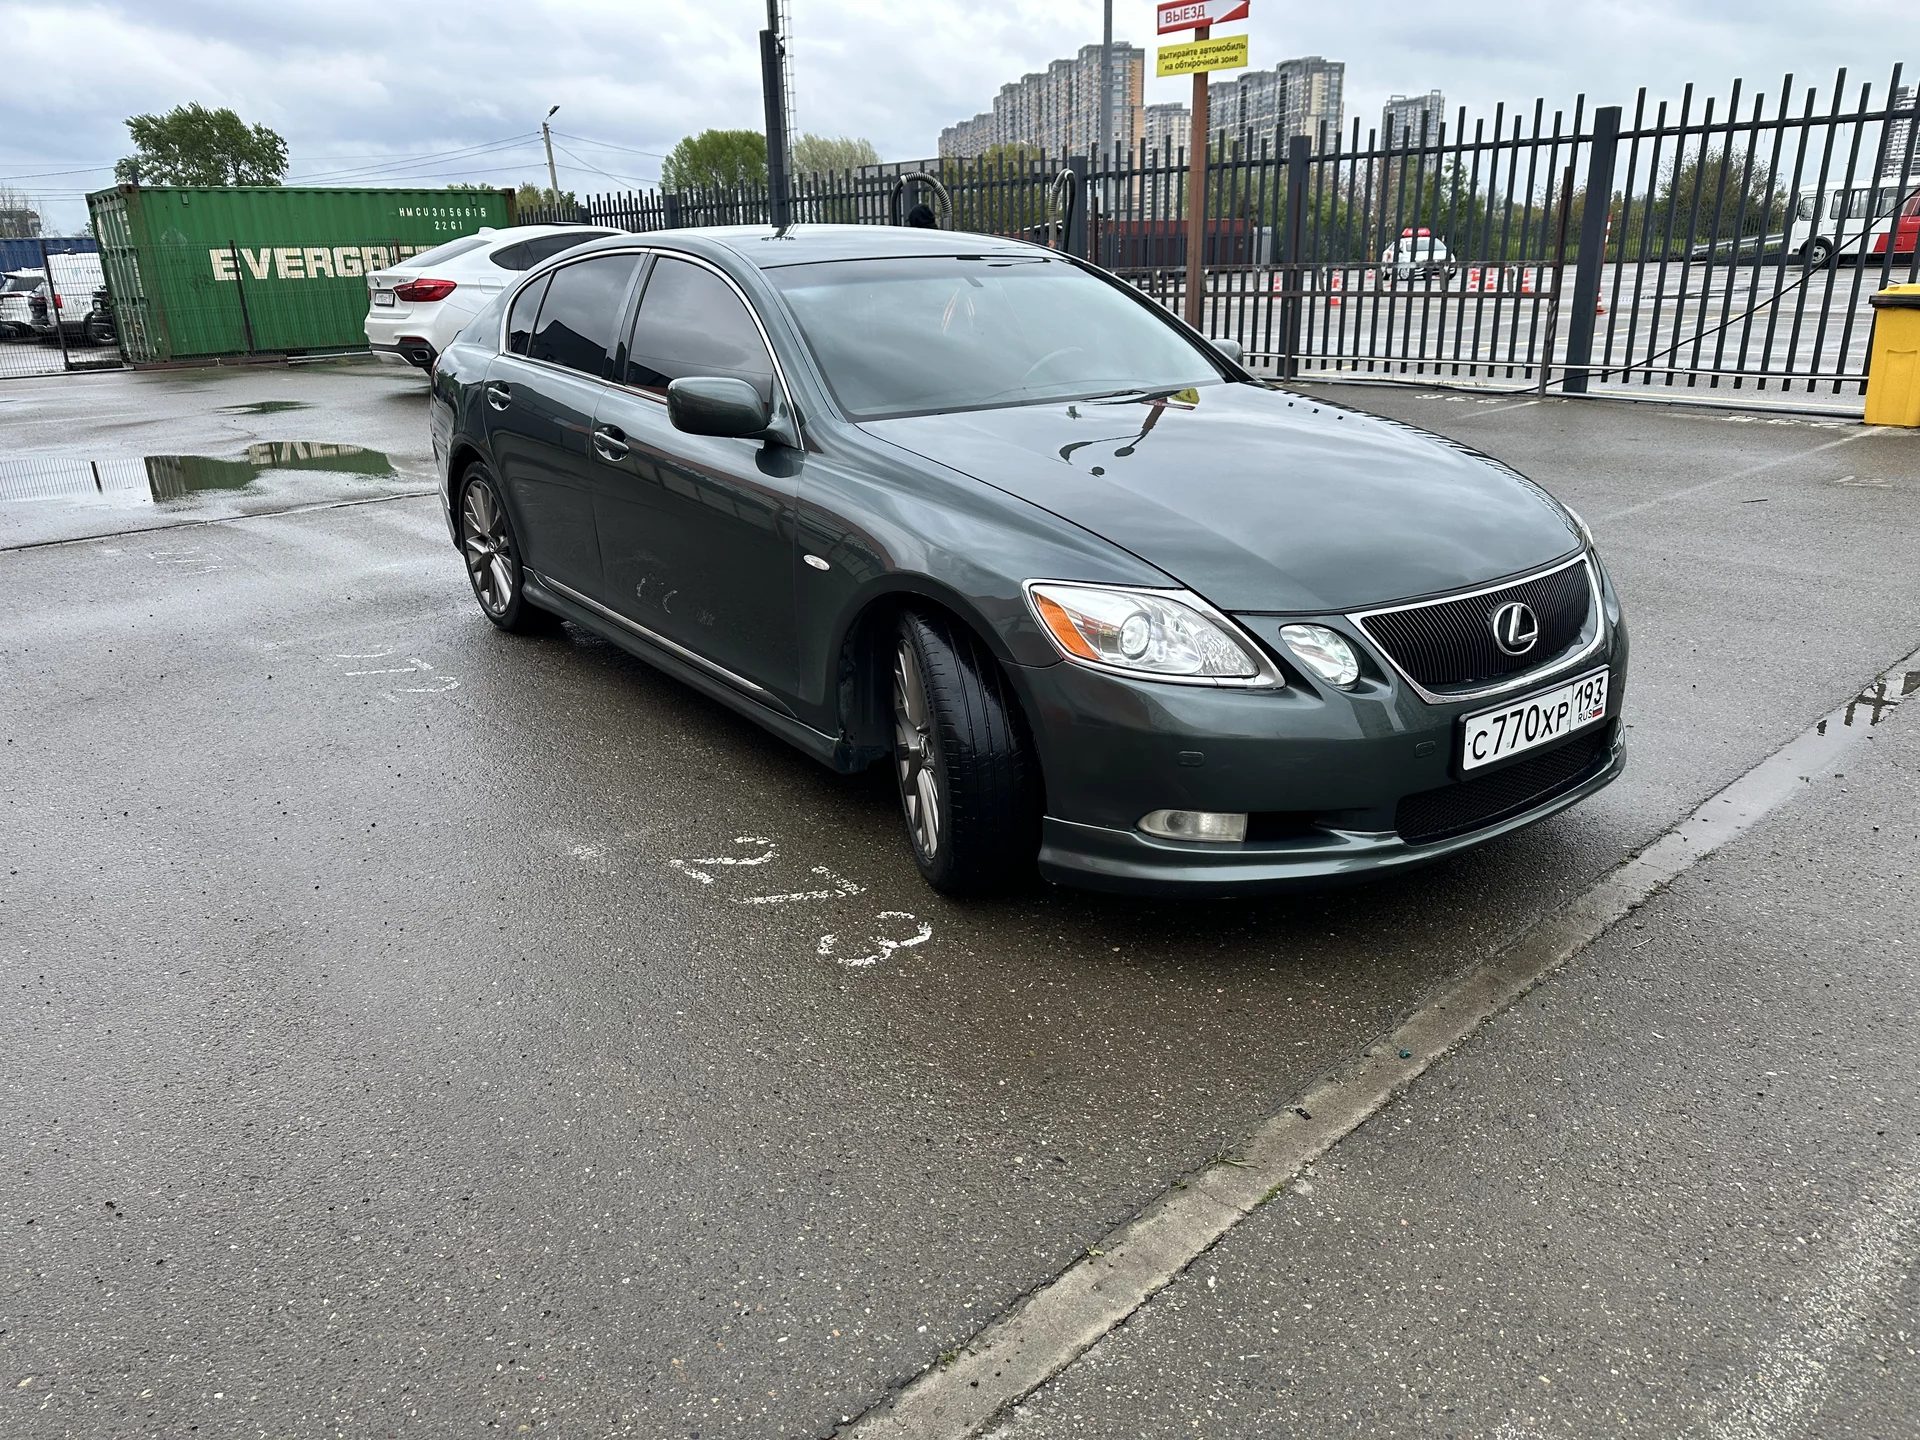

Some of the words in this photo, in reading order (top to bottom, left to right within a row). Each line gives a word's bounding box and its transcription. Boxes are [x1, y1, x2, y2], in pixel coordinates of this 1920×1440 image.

[1165, 4, 1205, 23] ВЫЕЗД
[1159, 48, 1198, 61] вытирайте
[1199, 42, 1246, 54] автомобиль
[1164, 62, 1173, 70] на
[1175, 56, 1219, 69] обтирочной
[1220, 55, 1239, 64] зоне
[1574, 676, 1604, 713] 193
[1577, 709, 1593, 723] RUS
